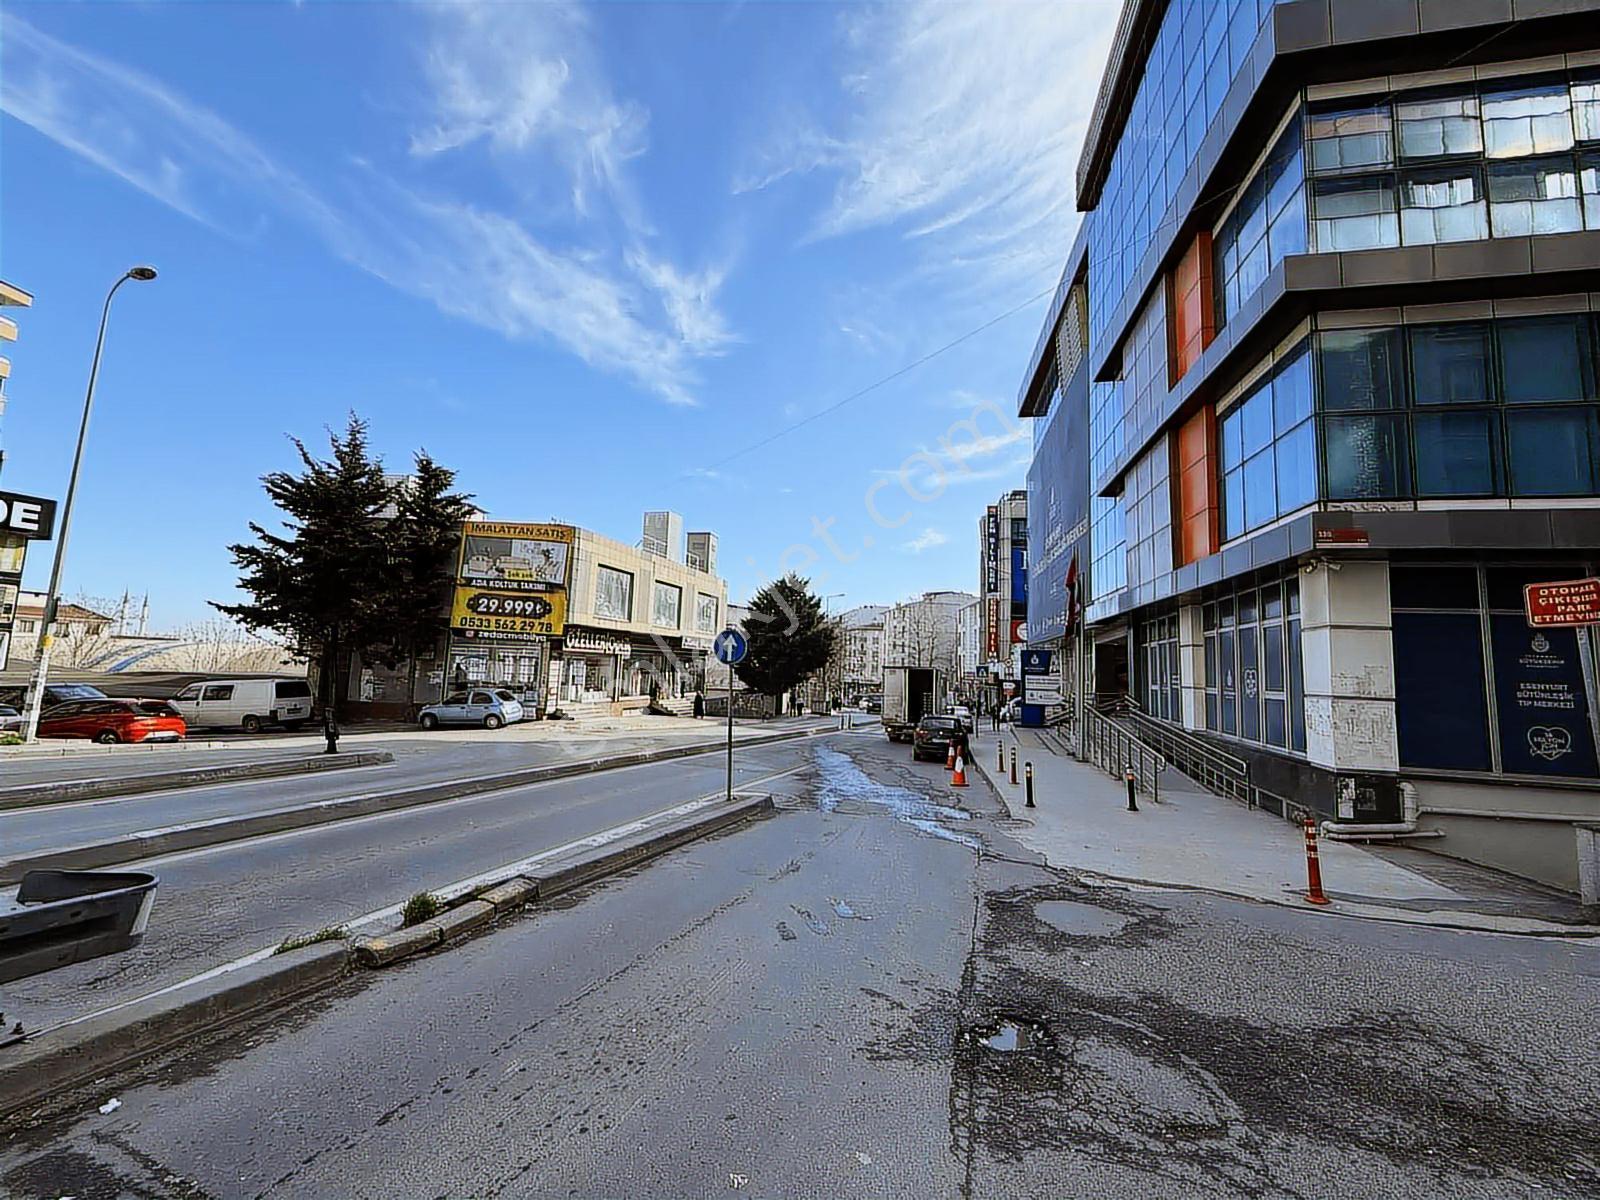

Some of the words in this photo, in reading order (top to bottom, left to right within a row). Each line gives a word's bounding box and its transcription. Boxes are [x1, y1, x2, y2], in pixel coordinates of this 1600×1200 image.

[471, 522, 534, 536] İMALATTAN
[535, 527, 568, 539] SATIŞ
[460, 616, 491, 629] 0533
[494, 619, 517, 631] 562
[519, 620, 536, 632] 29
[537, 621, 553, 633] 78
